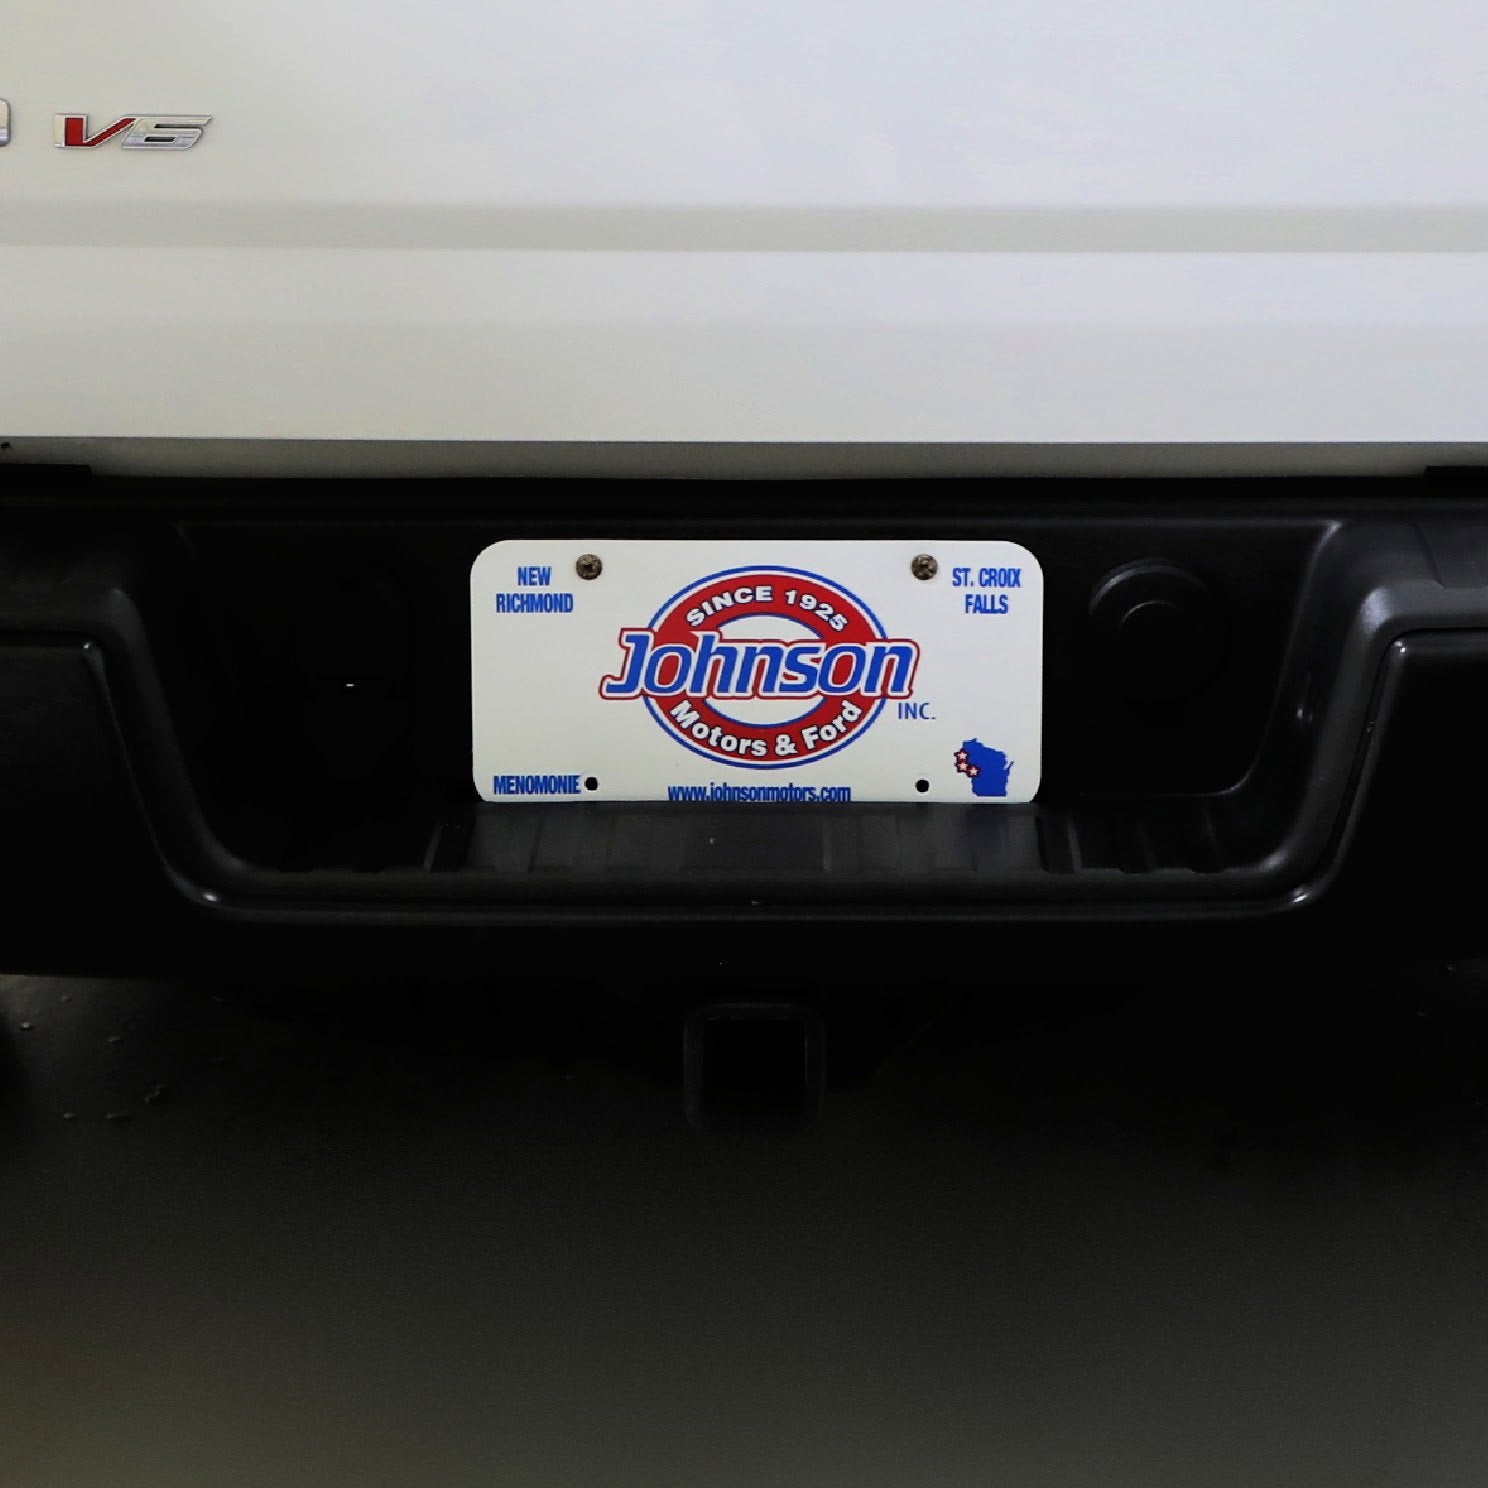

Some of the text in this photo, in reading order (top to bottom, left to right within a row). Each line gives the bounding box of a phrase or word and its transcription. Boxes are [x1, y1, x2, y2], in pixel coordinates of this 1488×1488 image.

[53, 113, 213, 152] V6
[517, 566, 552, 586] NEW
[952, 567, 1021, 588] ST. CROIX
[496, 593, 574, 613] RICHMOND
[686, 585, 848, 632] SINCE 1925
[965, 594, 1009, 614] FALLS
[602, 629, 917, 697] Johnson
[898, 702, 936, 719] INC.
[670, 699, 862, 757] Motors & Ford
[493, 775, 582, 795] MENOMONIE
[668, 781, 852, 802] www.johnsonmotors.com
